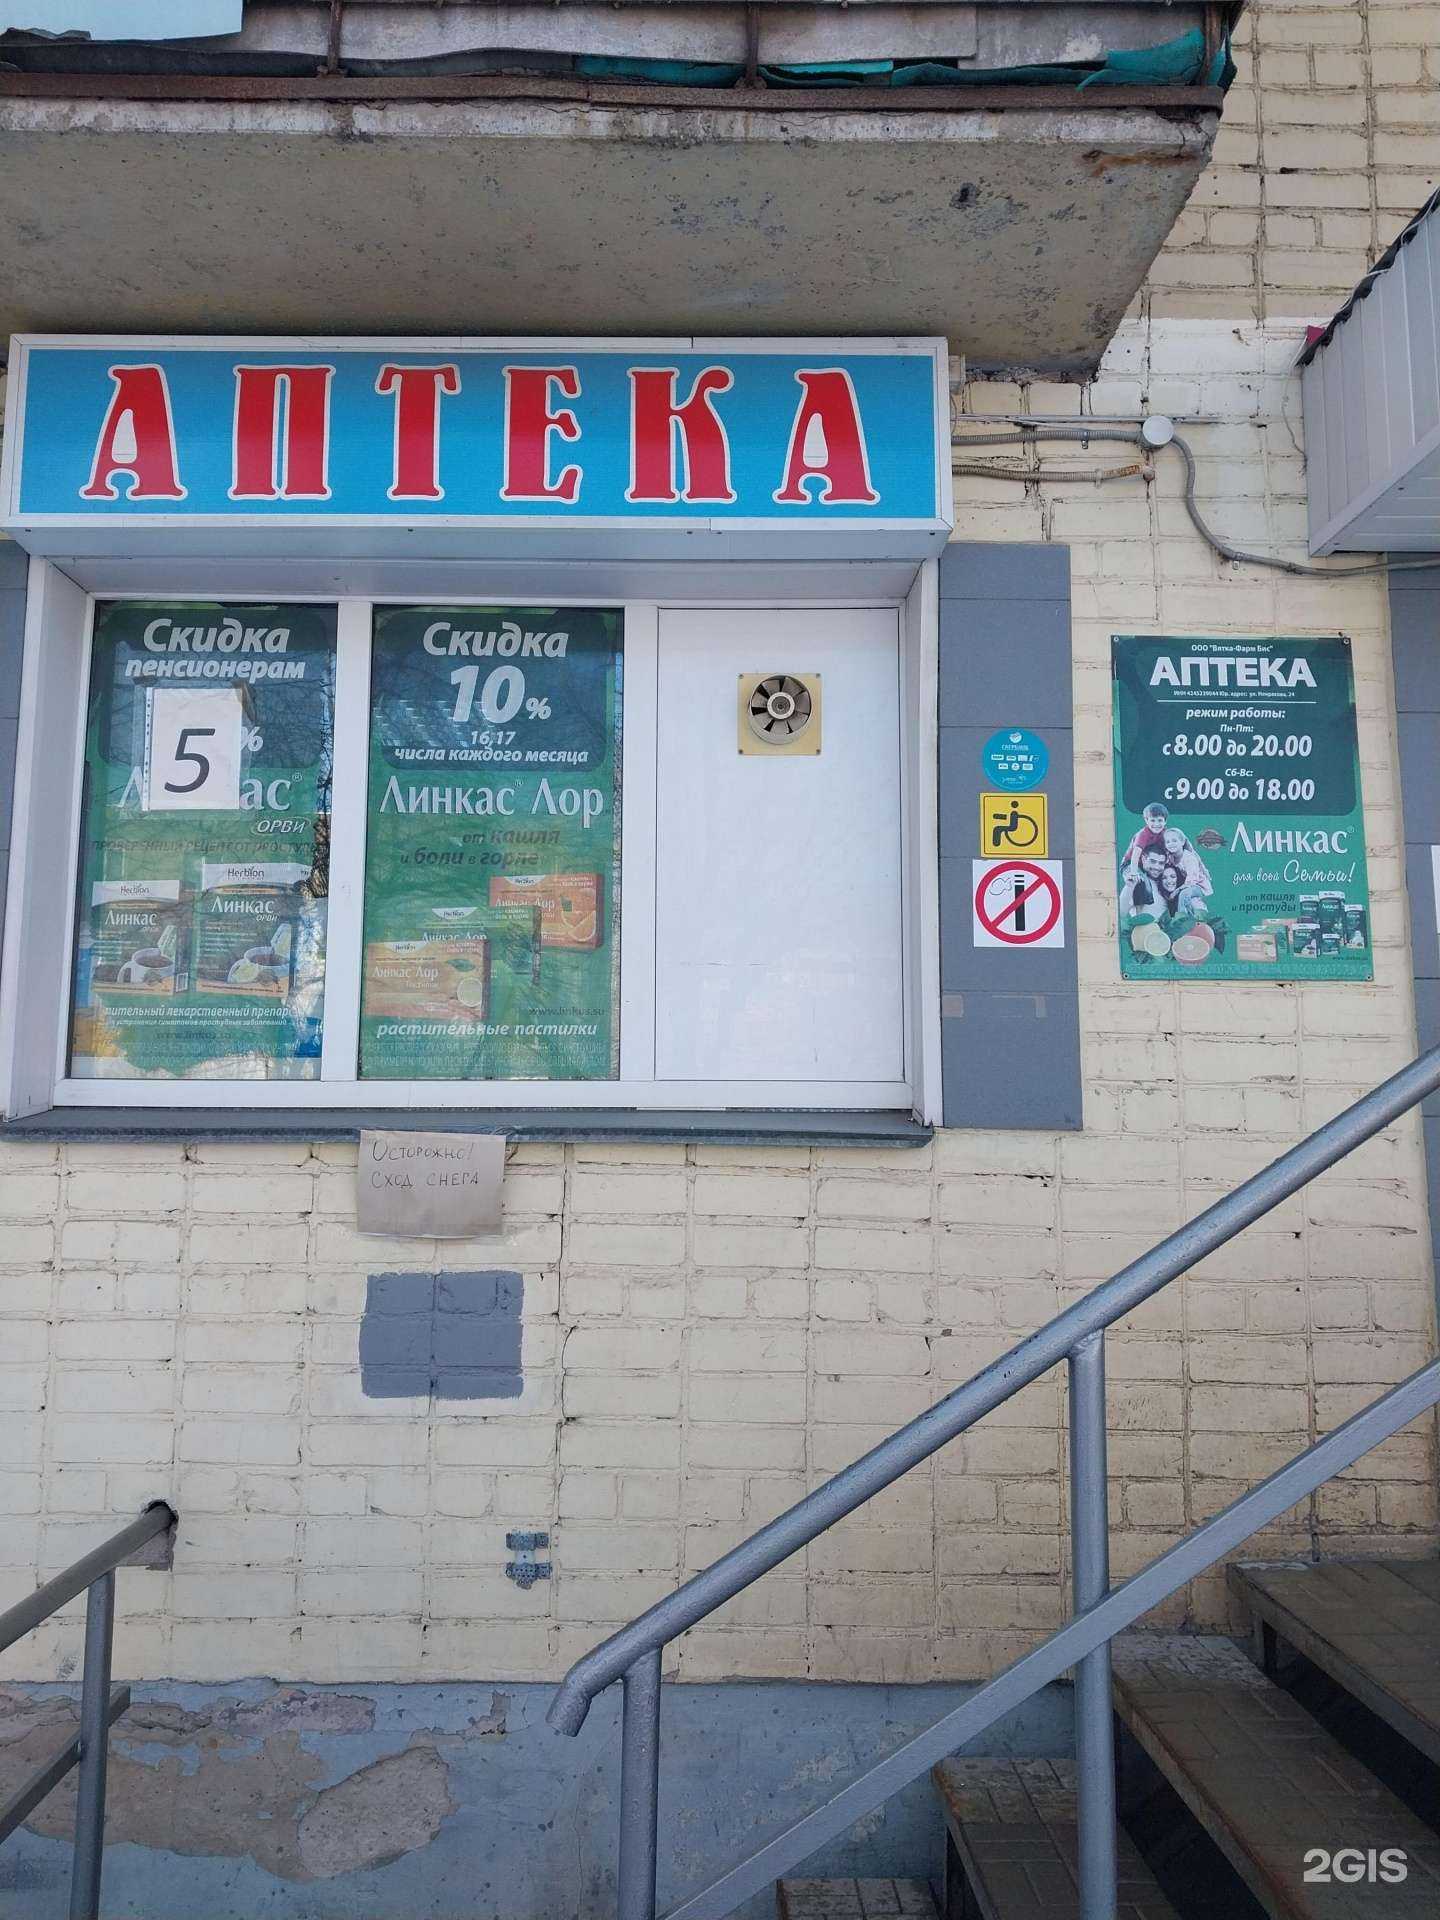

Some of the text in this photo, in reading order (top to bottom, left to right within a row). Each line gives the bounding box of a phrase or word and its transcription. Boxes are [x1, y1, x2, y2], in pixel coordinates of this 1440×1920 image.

[79, 364, 880, 505] АПТЕКА
[144, 618, 290, 653] Скидка
[423, 621, 569, 658] Скидка
[125, 659, 306, 683] пенсионерам
[1149, 656, 1317, 687] АПТЕКА
[1186, 707, 1286, 719] режим работы:
[1220, 724, 1254, 732] Пн-Пт:
[395, 743, 589, 765] числа каждого месяца
[1162, 734, 1312, 756] с 8.00 до 20.00
[164, 728, 216, 794] 5
[1225, 768, 1254, 777] Сб-Вс:
[1164, 777, 1315, 800] с 9.00 до 18.00
[531, 778, 604, 828] Лор
[257, 820, 306, 834] ОРВИ
[462, 830, 561, 844] от кашля
[400, 847, 540, 869] и боли в горле
[1232, 872, 1253, 885] для
[1284, 859, 1356, 883] Семьи!
[212, 896, 275, 914] Линкас
[1260, 892, 1296, 901] кашля
[105, 909, 158, 926] Линкас
[1239, 902, 1297, 914] простуды
[377, 1020, 598, 1038] растительные пастилки
